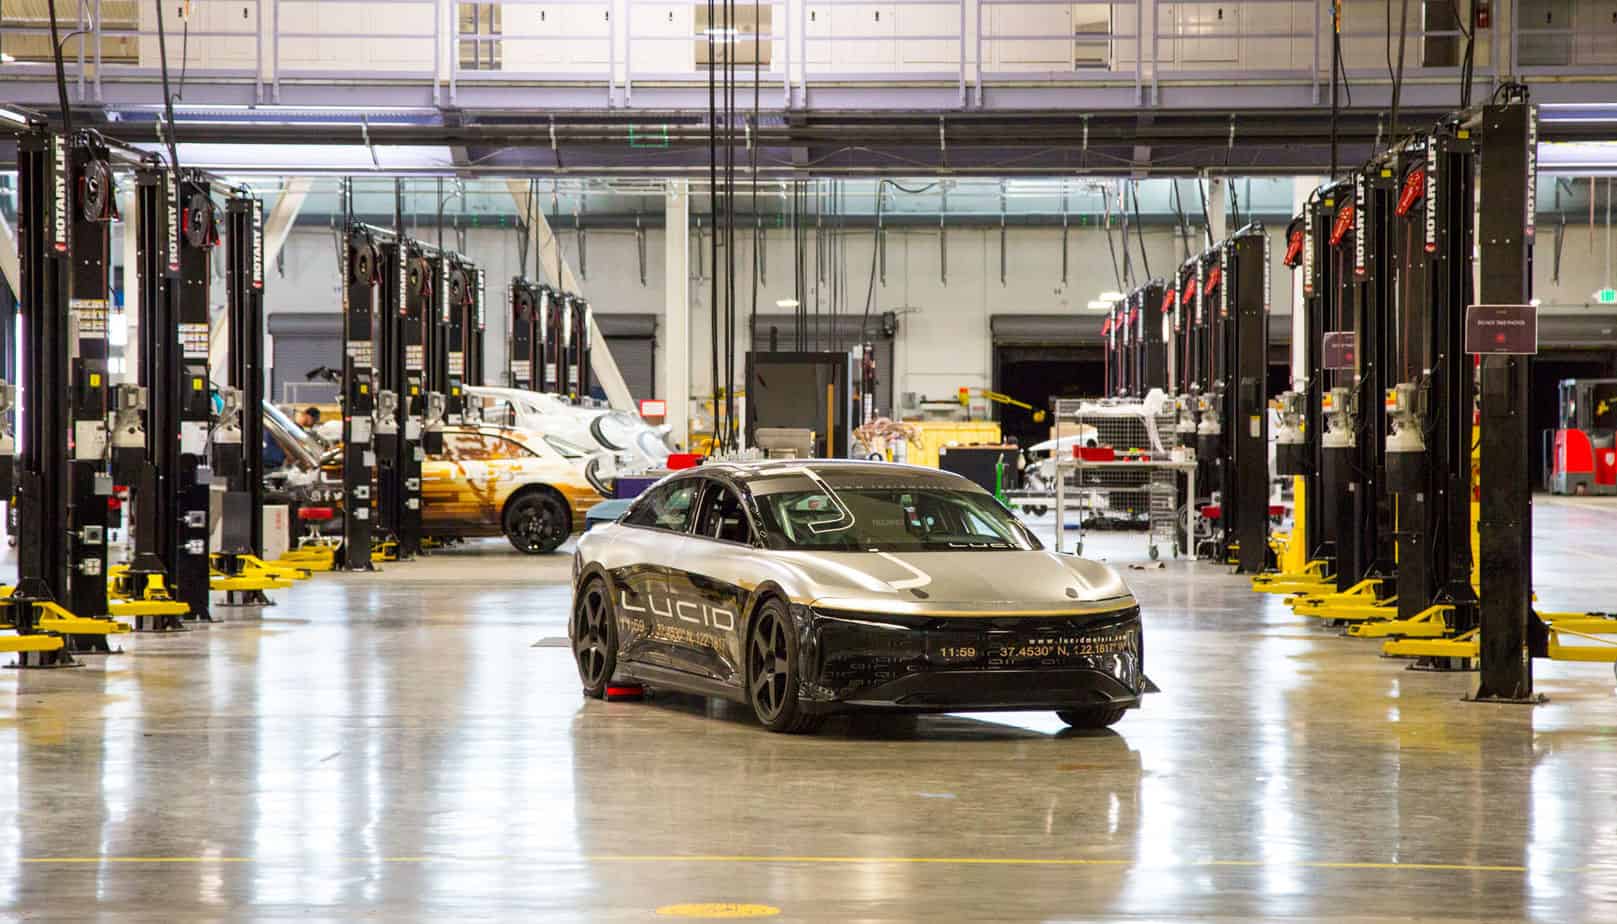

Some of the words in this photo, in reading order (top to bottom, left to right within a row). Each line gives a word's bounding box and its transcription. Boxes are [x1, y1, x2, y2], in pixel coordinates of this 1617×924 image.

[1529, 107, 1537, 145] LIFT
[56, 135, 65, 171] LIFT
[1427, 135, 1437, 171] LIFT
[167, 170, 177, 202] LIFT
[1356, 173, 1365, 205] LIFT
[1527, 151, 1536, 225] ROTARY
[55, 175, 65, 242] ROTARY
[253, 199, 262, 227] LIFT
[1305, 202, 1313, 230] LIFT
[1426, 176, 1436, 243] ROTARY
[168, 205, 178, 264] ROTARY
[1356, 209, 1365, 266] ROTARY
[253, 230, 262, 281] ROTARY
[1304, 233, 1312, 284] ROTARY
[621, 590, 734, 631] LUCID
[941, 647, 976, 657] 11:59
